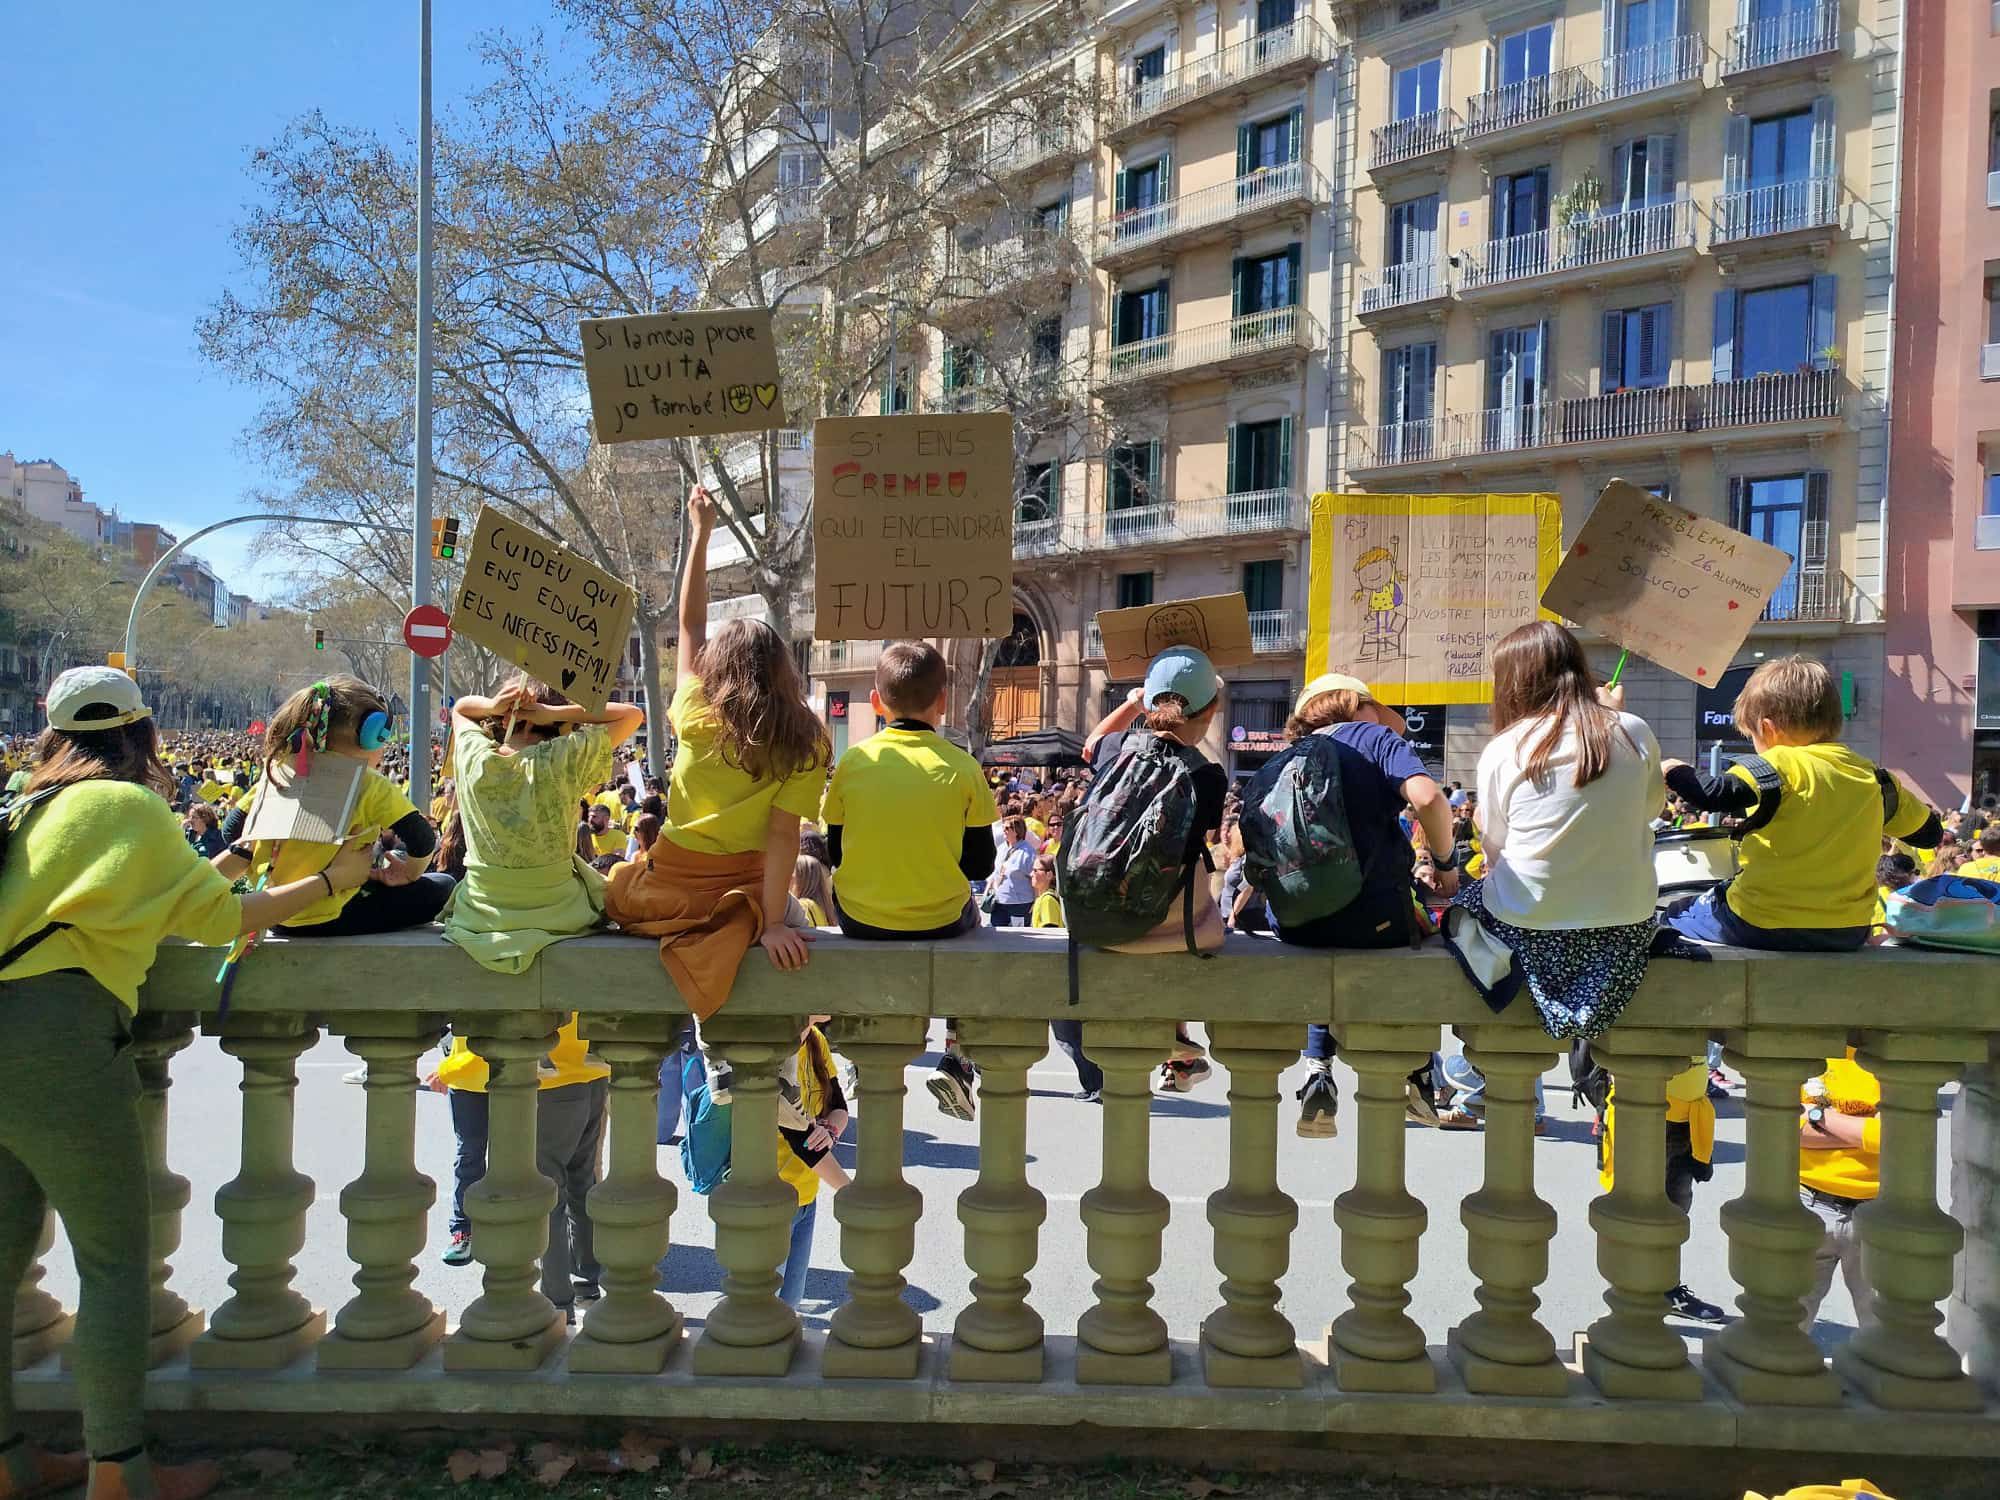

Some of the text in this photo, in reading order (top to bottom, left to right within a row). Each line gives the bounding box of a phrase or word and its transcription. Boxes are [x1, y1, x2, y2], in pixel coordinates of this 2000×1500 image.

[595, 324, 612, 350] Si
[624, 325, 641, 349] la
[648, 327, 695, 347] meva
[624, 353, 711, 388] LLUITA
[917, 429, 976, 457] ENS
[820, 516, 864, 539] QUI
[1505, 535, 1537, 549] AMB
[1641, 503, 1736, 558] PROBLEMA
[491, 527, 618, 609] CUIDEU QUI
[895, 548, 931, 568] EL
[484, 560, 521, 591] ENS
[1690, 553, 1713, 573] 26
[1711, 570, 1763, 600] ALUMNES
[463, 590, 494, 620] ELS
[831, 575, 1003, 633] FUTUR?
[1247, 731, 1269, 740] BAR
